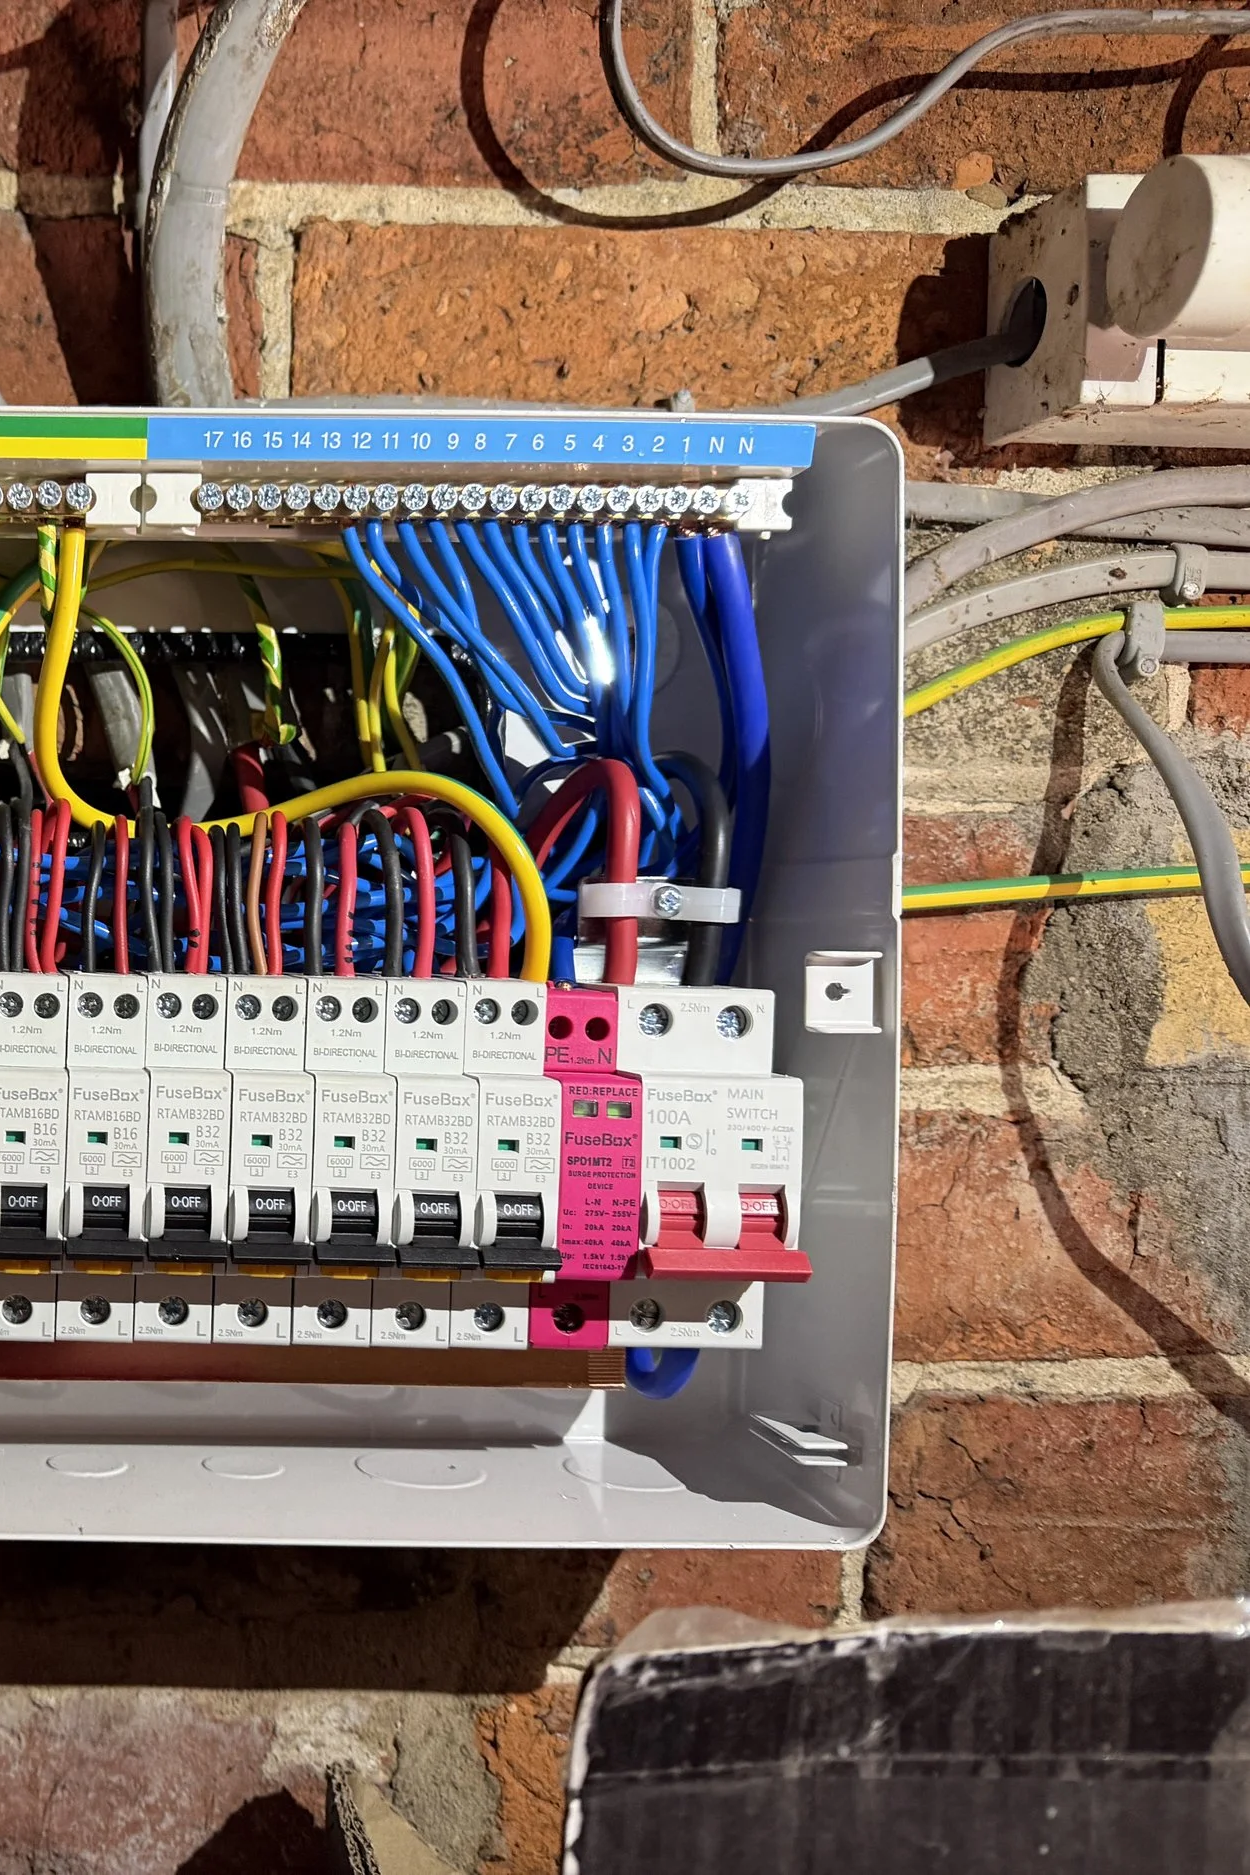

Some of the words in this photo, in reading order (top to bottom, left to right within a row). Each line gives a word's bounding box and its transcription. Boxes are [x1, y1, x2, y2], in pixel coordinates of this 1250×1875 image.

[204, 431, 223, 447] 17
[233, 431, 251, 448] 16
[264, 432, 282, 448] 15
[292, 432, 311, 448] 14
[322, 432, 341, 448] 13
[352, 432, 371, 448] 12
[382, 432, 398, 449] 11
[411, 433, 431, 449] 10
[448, 433, 459, 449] 9
[475, 433, 486, 450] 8
[506, 434, 517, 450] 7
[533, 434, 544, 450] 6
[564, 434, 575, 450] 5
[593, 435, 604, 451] 4
[622, 435, 634, 451] 3
[653, 436, 665, 452] 2
[683, 437, 690, 453] 1
[710, 437, 724, 453] N
[739, 437, 753, 454] N
[628, 1000, 634, 1009] L
[757, 1005, 765, 1013] N
[12, 1026, 42, 1034] 1.2Nm
[92, 1026, 121, 1034] 1.2Nm
[172, 1025, 202, 1033] 1.2Nm
[332, 1029, 361, 1037] 1.2Nm
[413, 1031, 443, 1039] 1.2Nm
[491, 1032, 520, 1040] 1.2Nm
[74, 1045, 137, 1054] BI-DIRECTIONAL
[154, 1044, 218, 1053] BI-DIRECTIONAL
[234, 1046, 297, 1056] BI-DIRECTIONAL
[314, 1048, 377, 1057] BI-DIRECTIONAL
[395, 1050, 459, 1060] BI-DIRECTIONAL
[473, 1050, 537, 1060] BI-DIRECTIONAL
[545, 1046, 569, 1063] PE
[598, 1048, 612, 1064] N
[728, 1088, 763, 1100] MAIN
[75, 1110, 141, 1122] RTAMB16BD
[158, 1108, 224, 1120] RTAMB32BD
[240, 1111, 307, 1123] RTAMB32BD
[323, 1112, 390, 1124] RTAMB32BD
[648, 1109, 691, 1125] 100A
[727, 1107, 778, 1120] SWITCH
[405, 1114, 473, 1127] RTAMB32BD
[487, 1115, 555, 1128] RTAMB32BD
[34, 1123, 57, 1135] B16
[114, 1127, 137, 1140] B16
[197, 1125, 219, 1138] B32
[279, 1128, 302, 1141] B32
[362, 1129, 385, 1142] B32
[445, 1132, 468, 1145] B32
[527, 1133, 550, 1145] B32
[33, 1138, 57, 1146] 30mA
[114, 1142, 137, 1150] 30mA
[196, 1140, 219, 1148] 30mA
[278, 1143, 302, 1151] 30mA
[361, 1144, 385, 1152] 30mA
[444, 1146, 467, 1154] 30mA
[526, 1147, 550, 1155] 30mA
[624, 1158, 635, 1167] T2
[646, 1156, 695, 1170] IT1002
[615, 1326, 621, 1335] L
[745, 1329, 753, 1339] N
